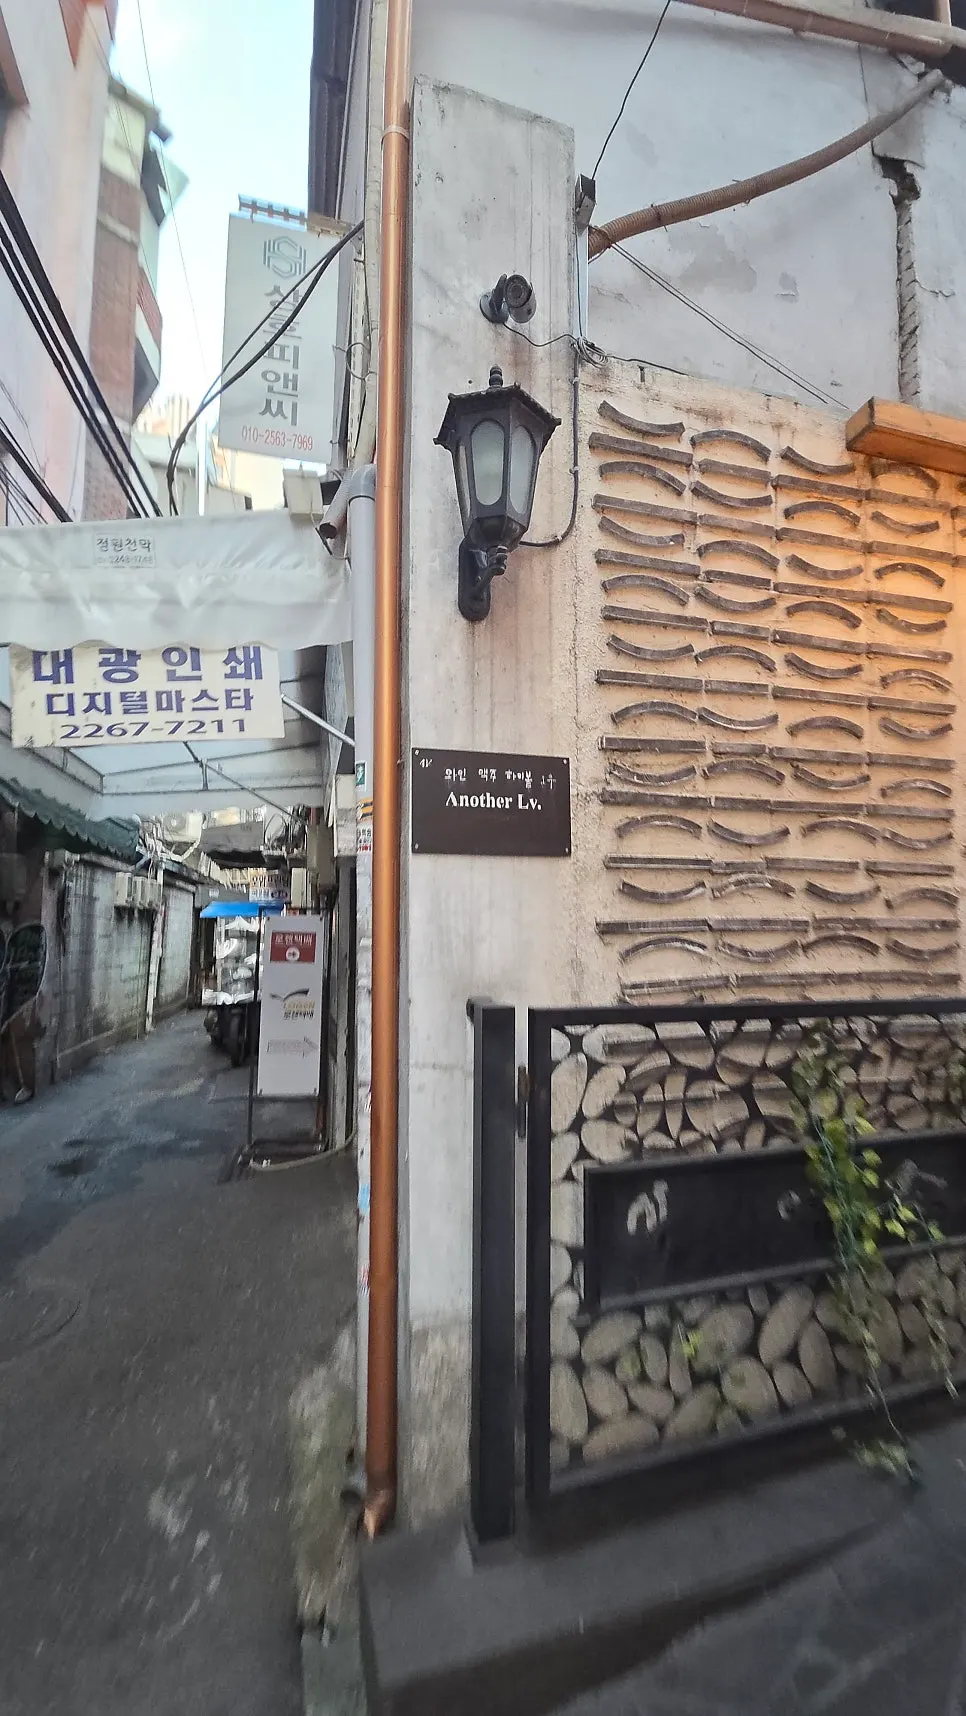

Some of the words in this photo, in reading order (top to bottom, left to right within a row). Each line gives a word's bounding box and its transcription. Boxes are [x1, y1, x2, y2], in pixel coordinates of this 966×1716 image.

[241, 425, 313, 450] 010-2563-7969
[46, 688, 254, 717] 디지털마스타
[60, 718, 246, 740] 2267-7211
[444, 767, 467, 782] 와인
[505, 769, 532, 789] 하이볼
[446, 791, 513, 809] Another
[518, 793, 542, 811] Lv.
